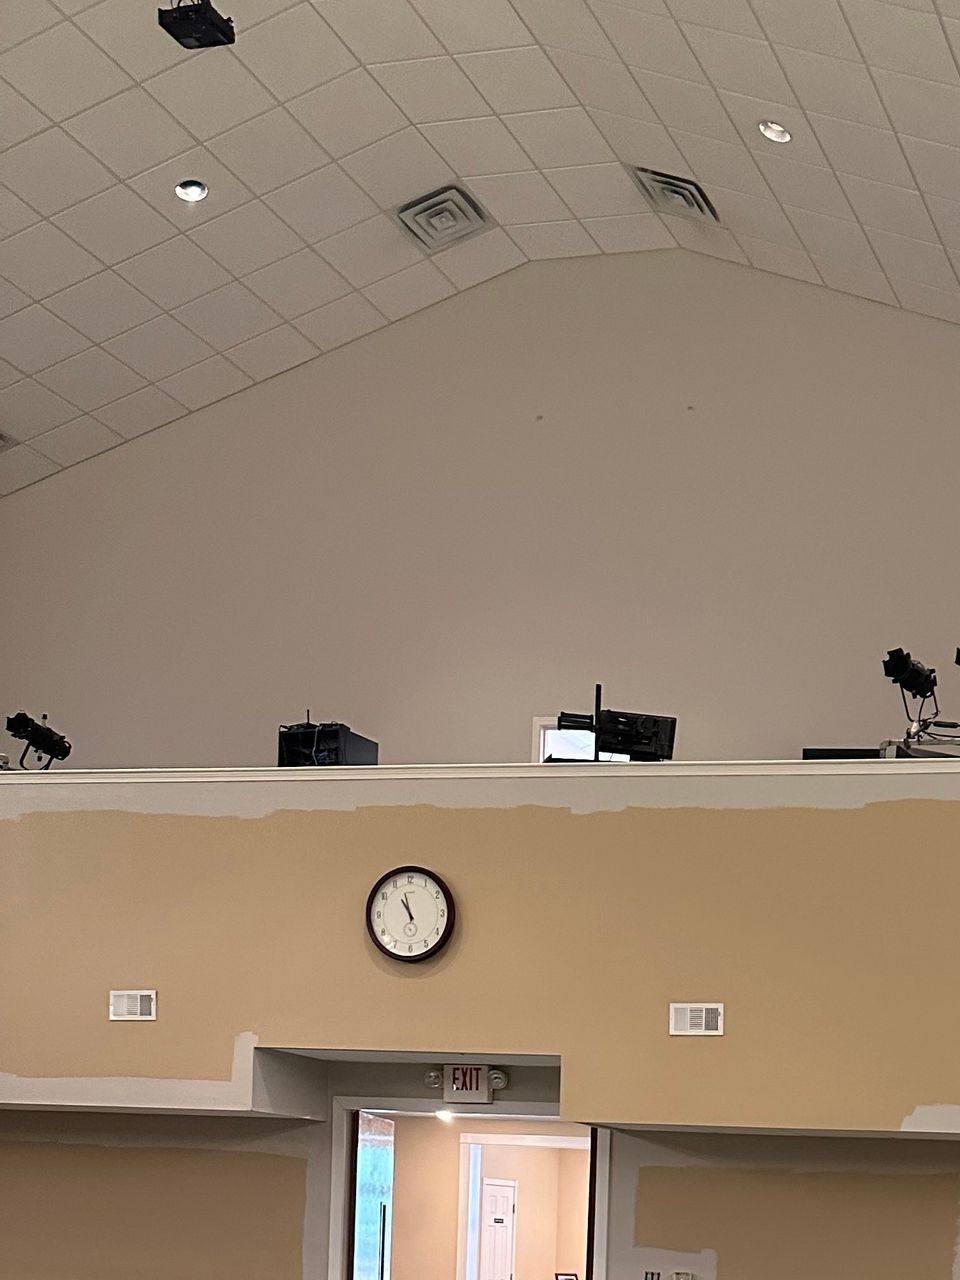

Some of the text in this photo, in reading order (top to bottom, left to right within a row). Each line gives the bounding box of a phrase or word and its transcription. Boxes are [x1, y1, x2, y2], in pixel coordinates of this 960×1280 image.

[407, 875, 415, 884] 12
[435, 890, 441, 900] 2
[376, 910, 382, 919] 9
[440, 909, 445, 918] 3
[381, 928, 386, 936] 8
[435, 927, 440, 936] 4
[393, 941, 398, 949] 7
[408, 943, 413, 953] 6
[424, 940, 429, 948] 5
[452, 1067, 482, 1091] EXIT
